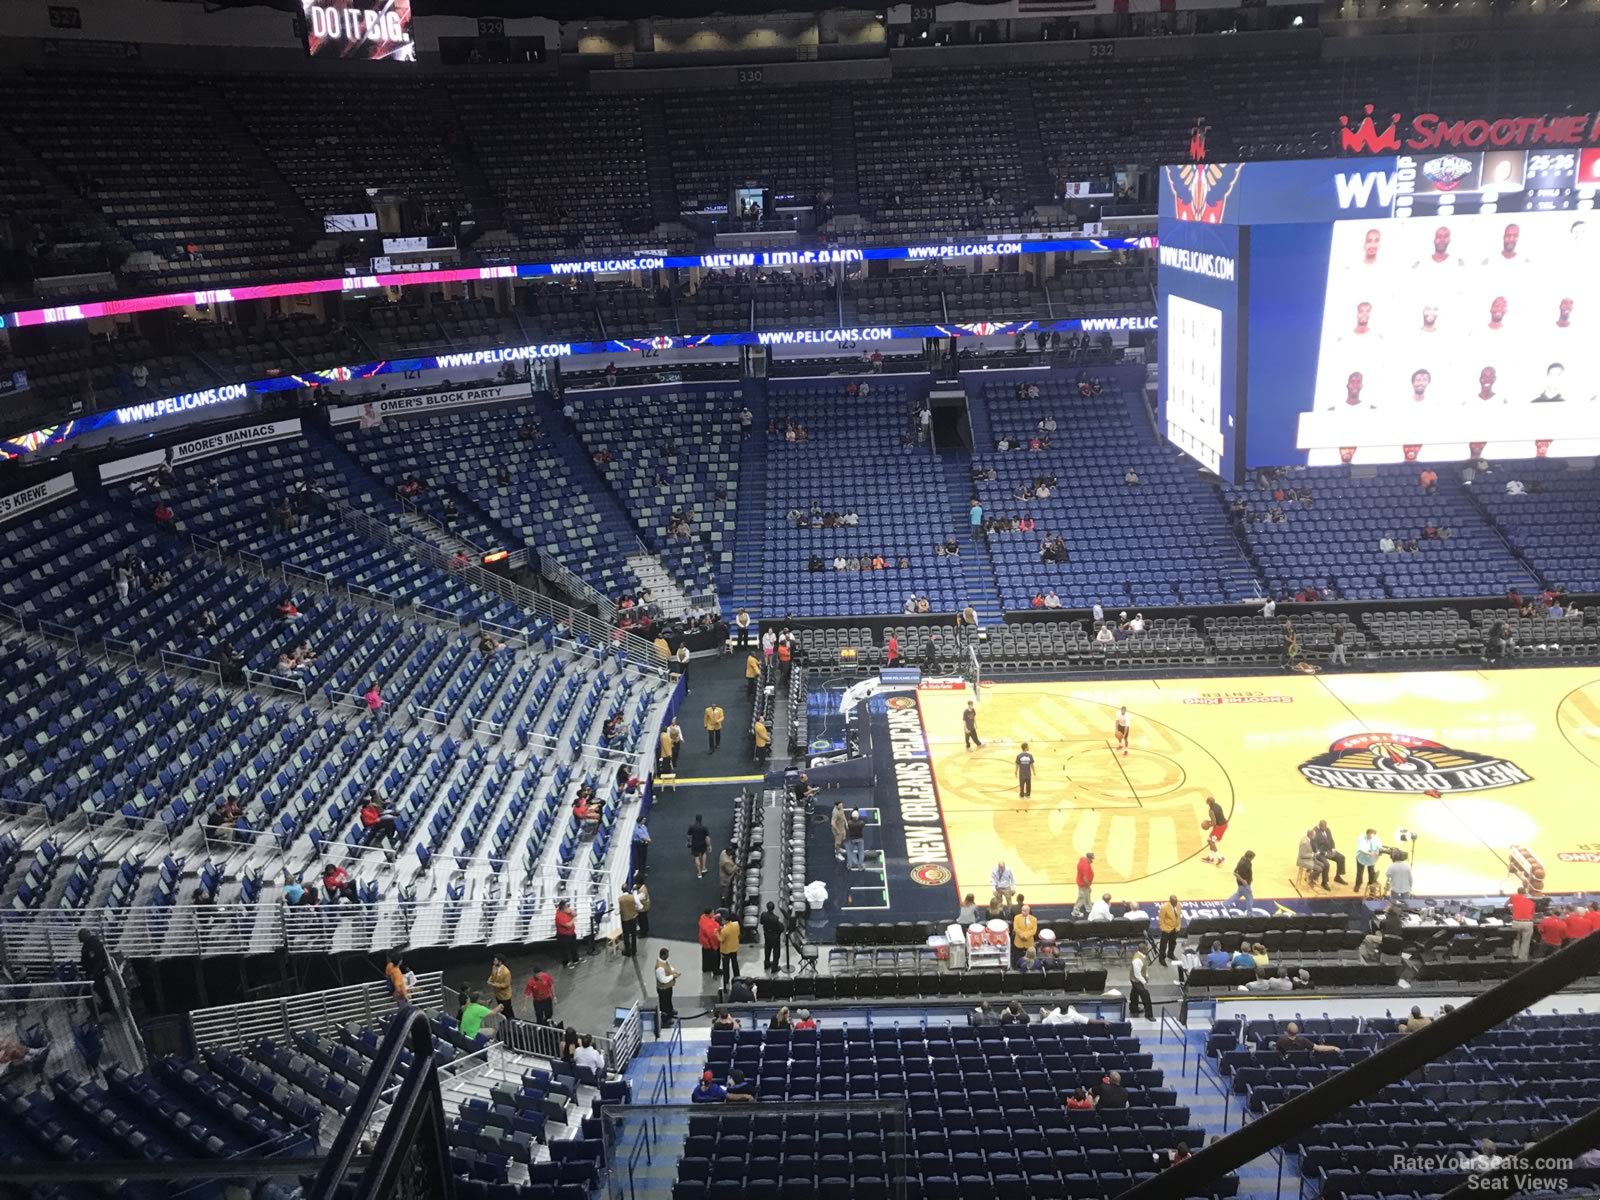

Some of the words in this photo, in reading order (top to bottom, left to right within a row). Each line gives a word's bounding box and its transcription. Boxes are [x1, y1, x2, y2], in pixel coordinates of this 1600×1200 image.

[311, 5, 340, 38] DO
[345, 8, 362, 41] IT
[913, 8, 934, 20] 331
[478, 21, 504, 34] 329
[1090, 45, 1114, 57] 332
[739, 70, 763, 82] 330
[1407, 113, 1589, 149] SMOOTHIE
[908, 243, 1022, 258] WWW.PELICANS.COM
[1159, 245, 1235, 281] WWW.PELICANS.COM
[550, 258, 664, 274] WWW.PELICANS.COM
[758, 327, 892, 344] WWW.PELICANS.COM
[1080, 316, 1159, 331] WWW.PELIC
[436, 343, 571, 368] WWW.PELICANS.COM
[116, 383, 247, 424] WWW.PELICANS.COM
[380, 397, 423, 412] OMER'S
[426, 392, 464, 406] BLOCK
[467, 388, 503, 400] PARTY
[178, 435, 224, 456] MOORE'S
[225, 425, 276, 446] MANIACS
[13, 485, 48, 507] KREWE
[886, 708, 928, 761] PELICANS
[1301, 766, 1452, 791] ORLEANS
[1456, 761, 1531, 789] NEW
[894, 762, 940, 823] ORLEANS
[904, 824, 949, 864] NEW
